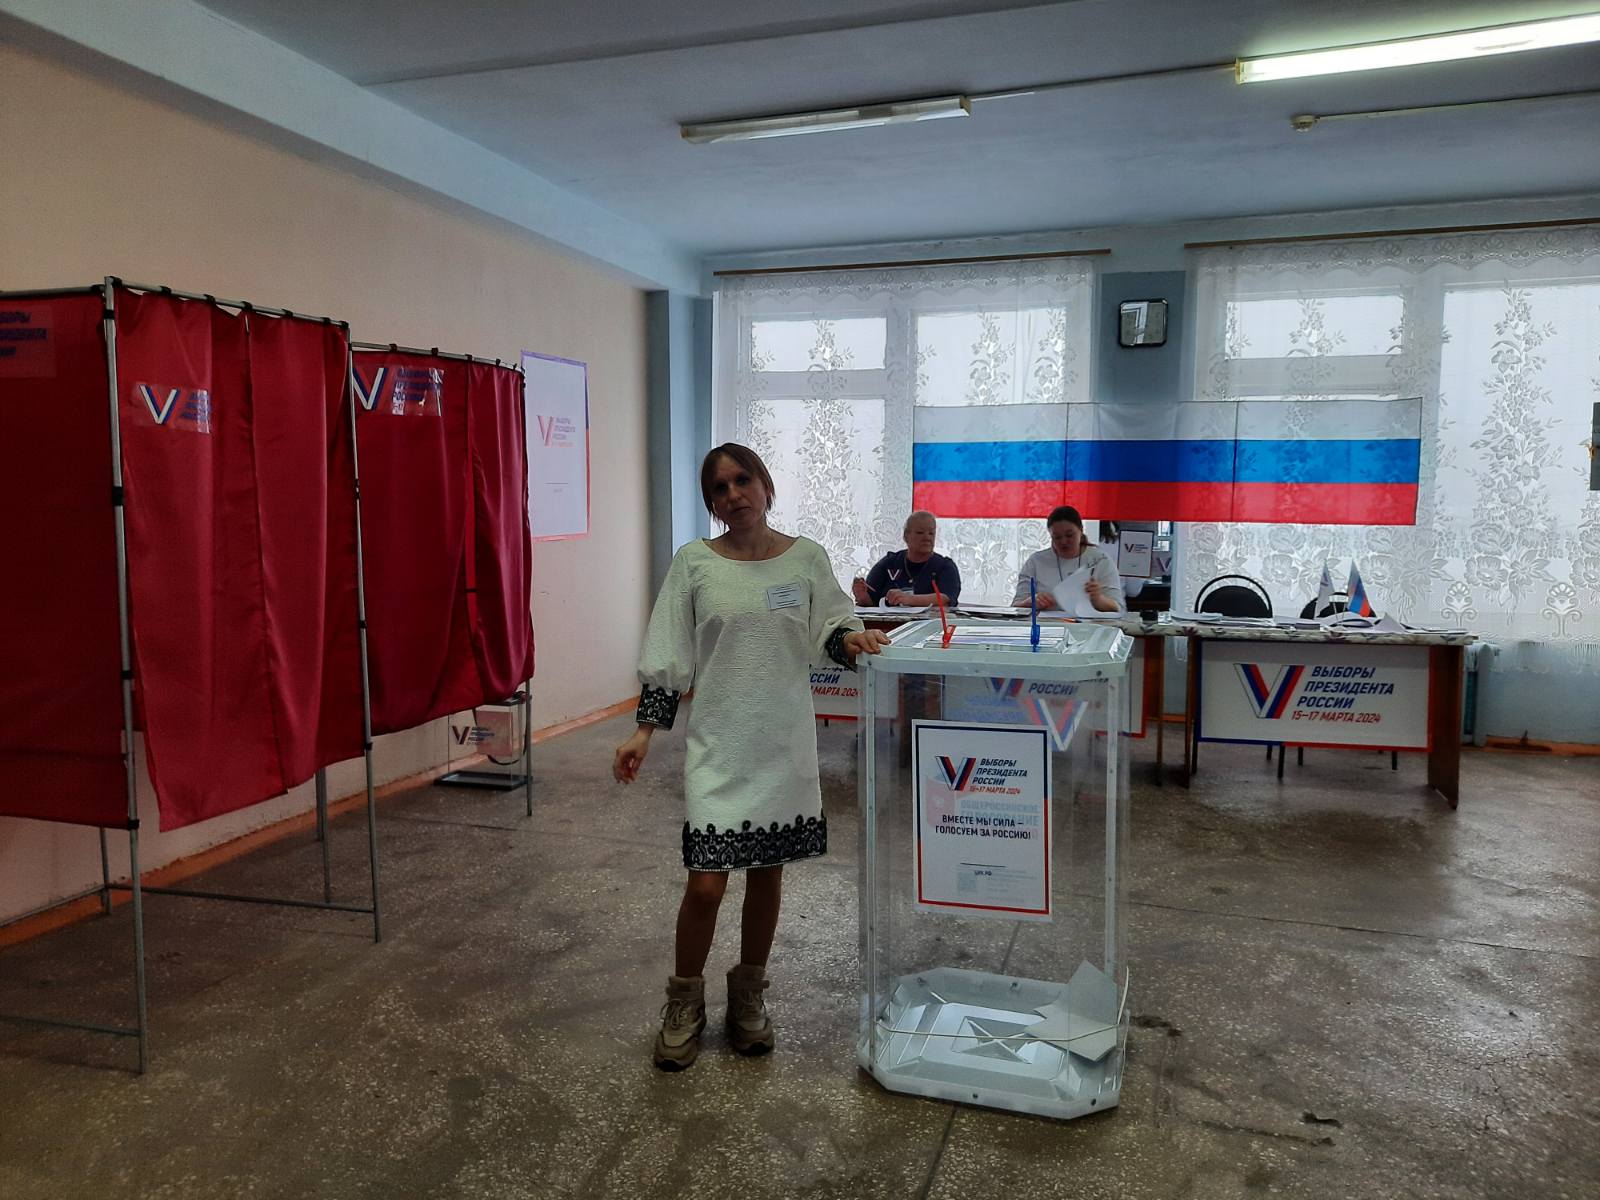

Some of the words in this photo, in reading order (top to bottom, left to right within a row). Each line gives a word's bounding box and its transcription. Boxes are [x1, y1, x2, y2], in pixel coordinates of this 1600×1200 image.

[140, 385, 183, 425] V
[810, 672, 840, 684] ССИИ
[1311, 666, 1376, 679] ВЫБОРЫ
[813, 686, 840, 696] МАРТА
[1028, 682, 1080, 695] РОССИИ
[1232, 663, 1305, 719] V
[1304, 681, 1395, 696] ПРЕЗИДЕНТА
[1296, 696, 1355, 709] РОССИИ
[1320, 712, 1354, 722] МАРТА
[1356, 712, 1381, 724] 2024
[980, 758, 1016, 767] ВЫБОРЫ
[936, 756, 976, 792] V
[976, 768, 1028, 778] ПРЕЗИДЕНТА
[986, 786, 1006, 794] МАРТА
[942, 814, 974, 824] ВМЕСТЕ
[976, 816, 991, 826] МЫ
[993, 818, 1016, 827] СИЛА
[936, 825, 978, 836] ГОЛОСУЕМ
[980, 828, 992, 837] ЗА
[992, 829, 1031, 840] РОССИЮ!
